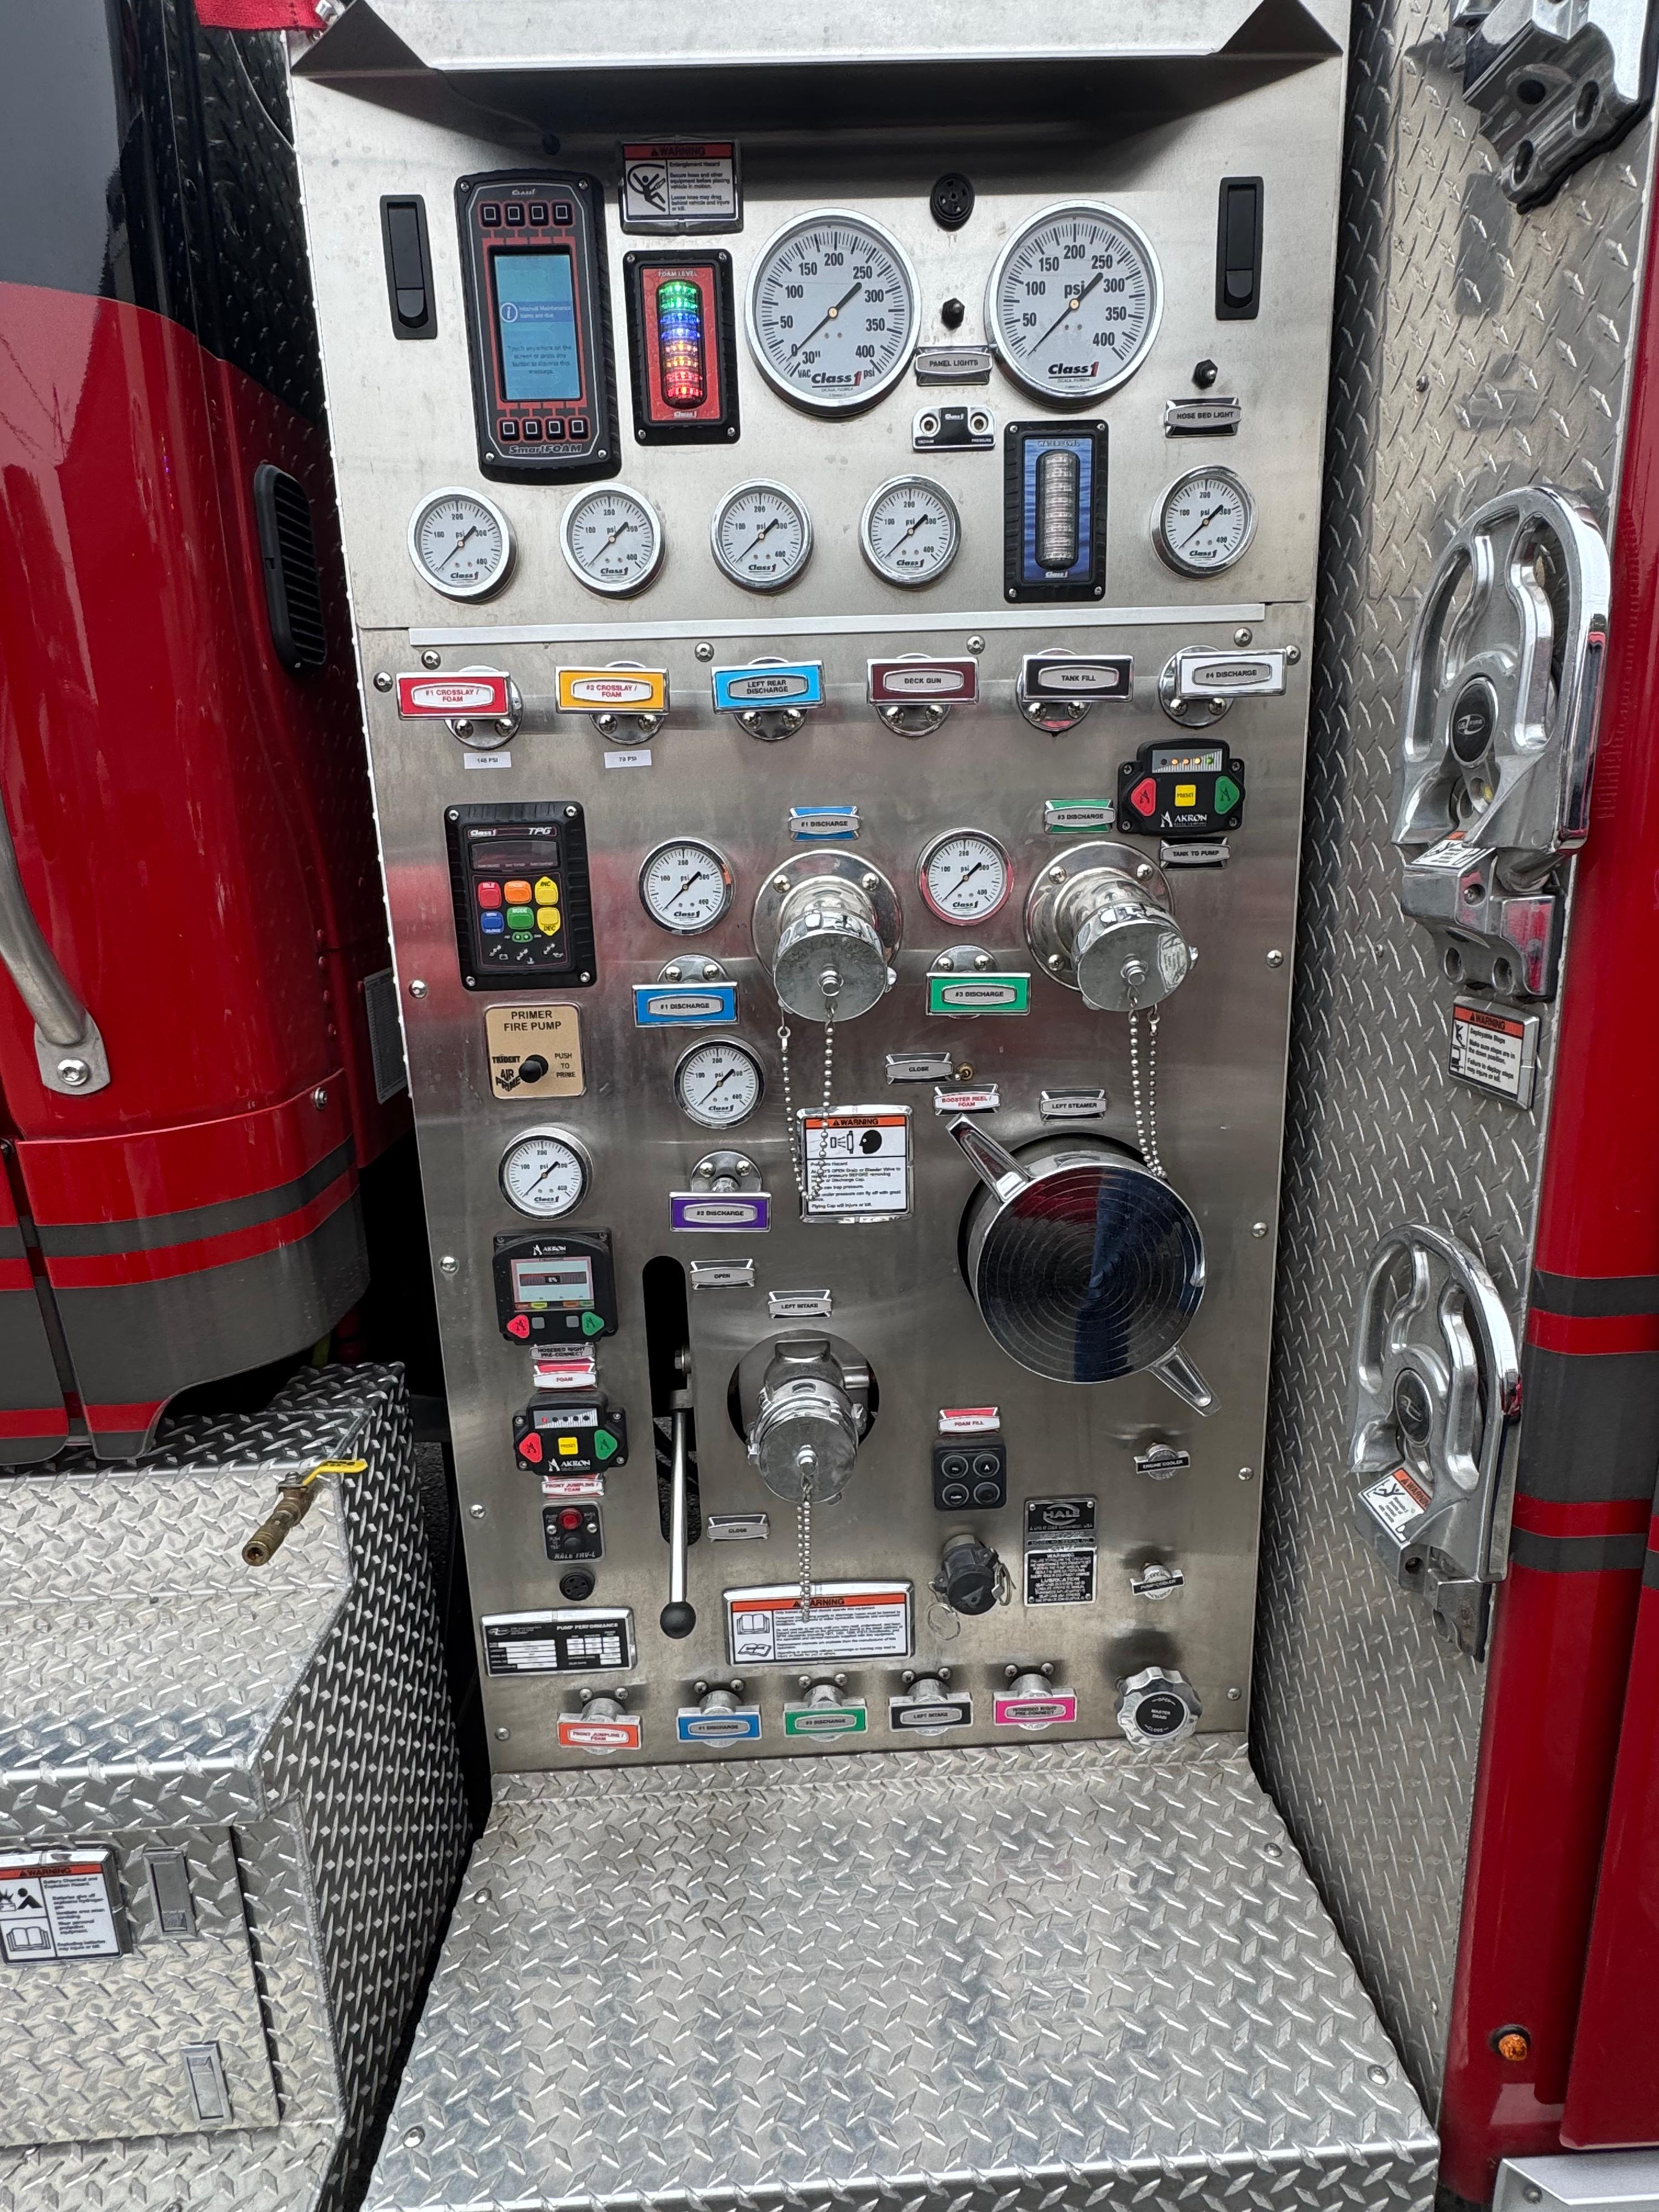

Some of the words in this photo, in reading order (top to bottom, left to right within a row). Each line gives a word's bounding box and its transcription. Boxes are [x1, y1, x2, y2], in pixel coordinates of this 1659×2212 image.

[660, 147, 705, 156] WARNING
[1064, 244, 1085, 259] 200
[825, 253, 843, 266] 200
[1039, 257, 1059, 272] 150
[1092, 254, 1112, 269] 250
[799, 262, 817, 275] 150
[853, 266, 872, 279] 250
[785, 285, 804, 298] 100
[1025, 281, 1045, 295] 100
[1065, 281, 1085, 299] psi
[1103, 278, 1125, 293] 300
[864, 290, 884, 302] 300
[1022, 312, 1036, 326] 50
[1105, 306, 1126, 321] 350
[780, 316, 793, 328] 50
[866, 318, 884, 331] 350
[1093, 332, 1114, 346] 400
[791, 344, 798, 356] 0
[855, 345, 874, 358] 400
[798, 369, 811, 378] VAC
[864, 367, 875, 379] psi
[509, 445, 582, 455] SmartFOAM
[1200, 509, 1211, 518] psi
[757, 523, 765, 531] psi
[905, 518, 915, 526] psi
[456, 530, 465, 539] psi
[607, 525, 616, 535] psi
[1175, 814, 1207, 822] AKRON
[961, 865, 970, 873] psi
[681, 874, 690, 883] psi
[512, 1010, 552, 1019] PRIMER
[504, 1023, 528, 1031] FIRE
[531, 1021, 561, 1030] PUMP
[1476, 1014, 1505, 1030] WARNING
[501, 1069, 514, 1081] AIR
[495, 1076, 520, 1092] PRIME
[29, 1867, 71, 1876] WARNING
